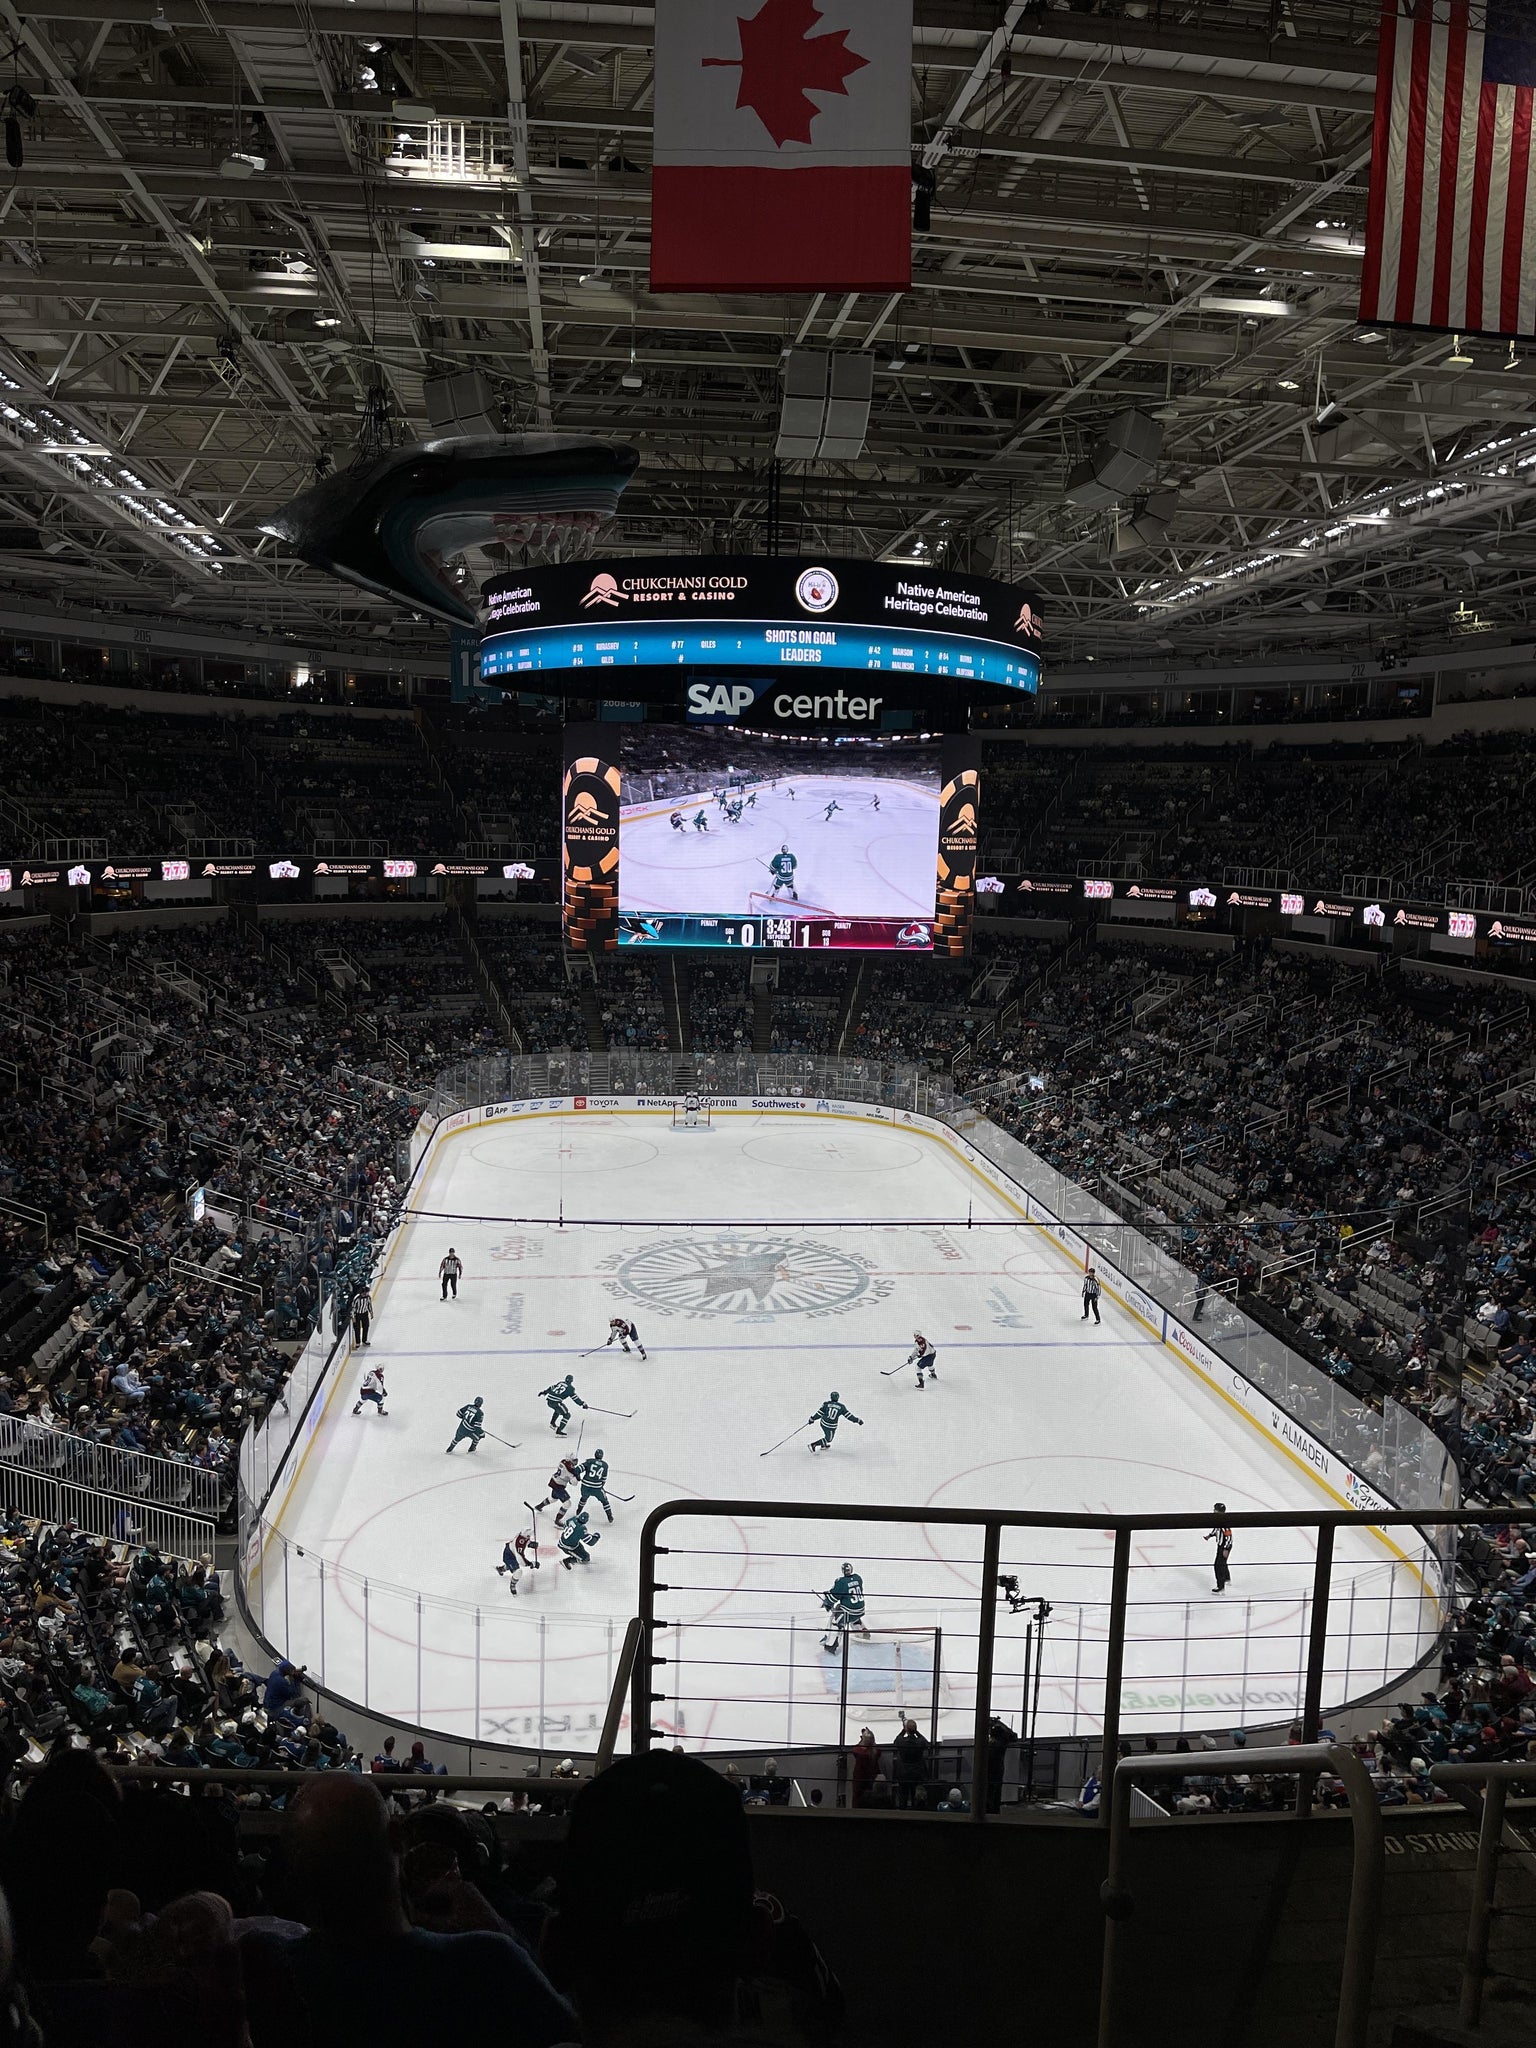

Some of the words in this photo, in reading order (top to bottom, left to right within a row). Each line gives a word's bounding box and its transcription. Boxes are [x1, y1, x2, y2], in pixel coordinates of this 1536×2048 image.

[622, 576, 706, 590] CHUKCHANSI
[708, 576, 748, 589] GOLD
[502, 587, 532, 602] American
[633, 592, 674, 602] RESORT
[678, 592, 686, 600] &
[692, 592, 735, 600] CASINO
[897, 582, 934, 598] Native
[935, 586, 980, 606] American
[502, 600, 540, 617] Celebration
[884, 596, 934, 615] Heritage
[935, 602, 988, 622] Celebration
[460, 638, 480, 646] MARL
[737, 640, 741, 649] 2
[766, 630, 797, 644] SHOTS
[799, 630, 811, 644] ON
[813, 631, 837, 645] GOAL
[678, 655, 684, 663] #
[781, 648, 822, 662] LEADERS
[1352, 664, 1366, 676] 212
[688, 683, 755, 716] SAP
[774, 690, 882, 720] center
[781, 862, 792, 873] 30
[767, 919, 791, 935] 3:43
[727, 936, 731, 944] 4
[741, 924, 754, 947] 0
[801, 925, 810, 948] 1
[823, 938, 830, 946] 13
[752, 1100, 799, 1109] Southwest
[595, 1254, 625, 1270] SAP
[622, 1237, 694, 1254] Center
[800, 1240, 842, 1252] San
[840, 1253, 879, 1270] Jose
[601, 1281, 636, 1300] Jose
[870, 1280, 895, 1298] SAP
[634, 1300, 680, 1316] San
[806, 1297, 879, 1319] Center
[1179, 1330, 1196, 1356] Coors
[1196, 1350, 1212, 1371] LIGHT
[828, 1407, 838, 1420] 10
[1282, 1423, 1329, 1474] ALMADEN
[589, 1464, 604, 1480] 54
